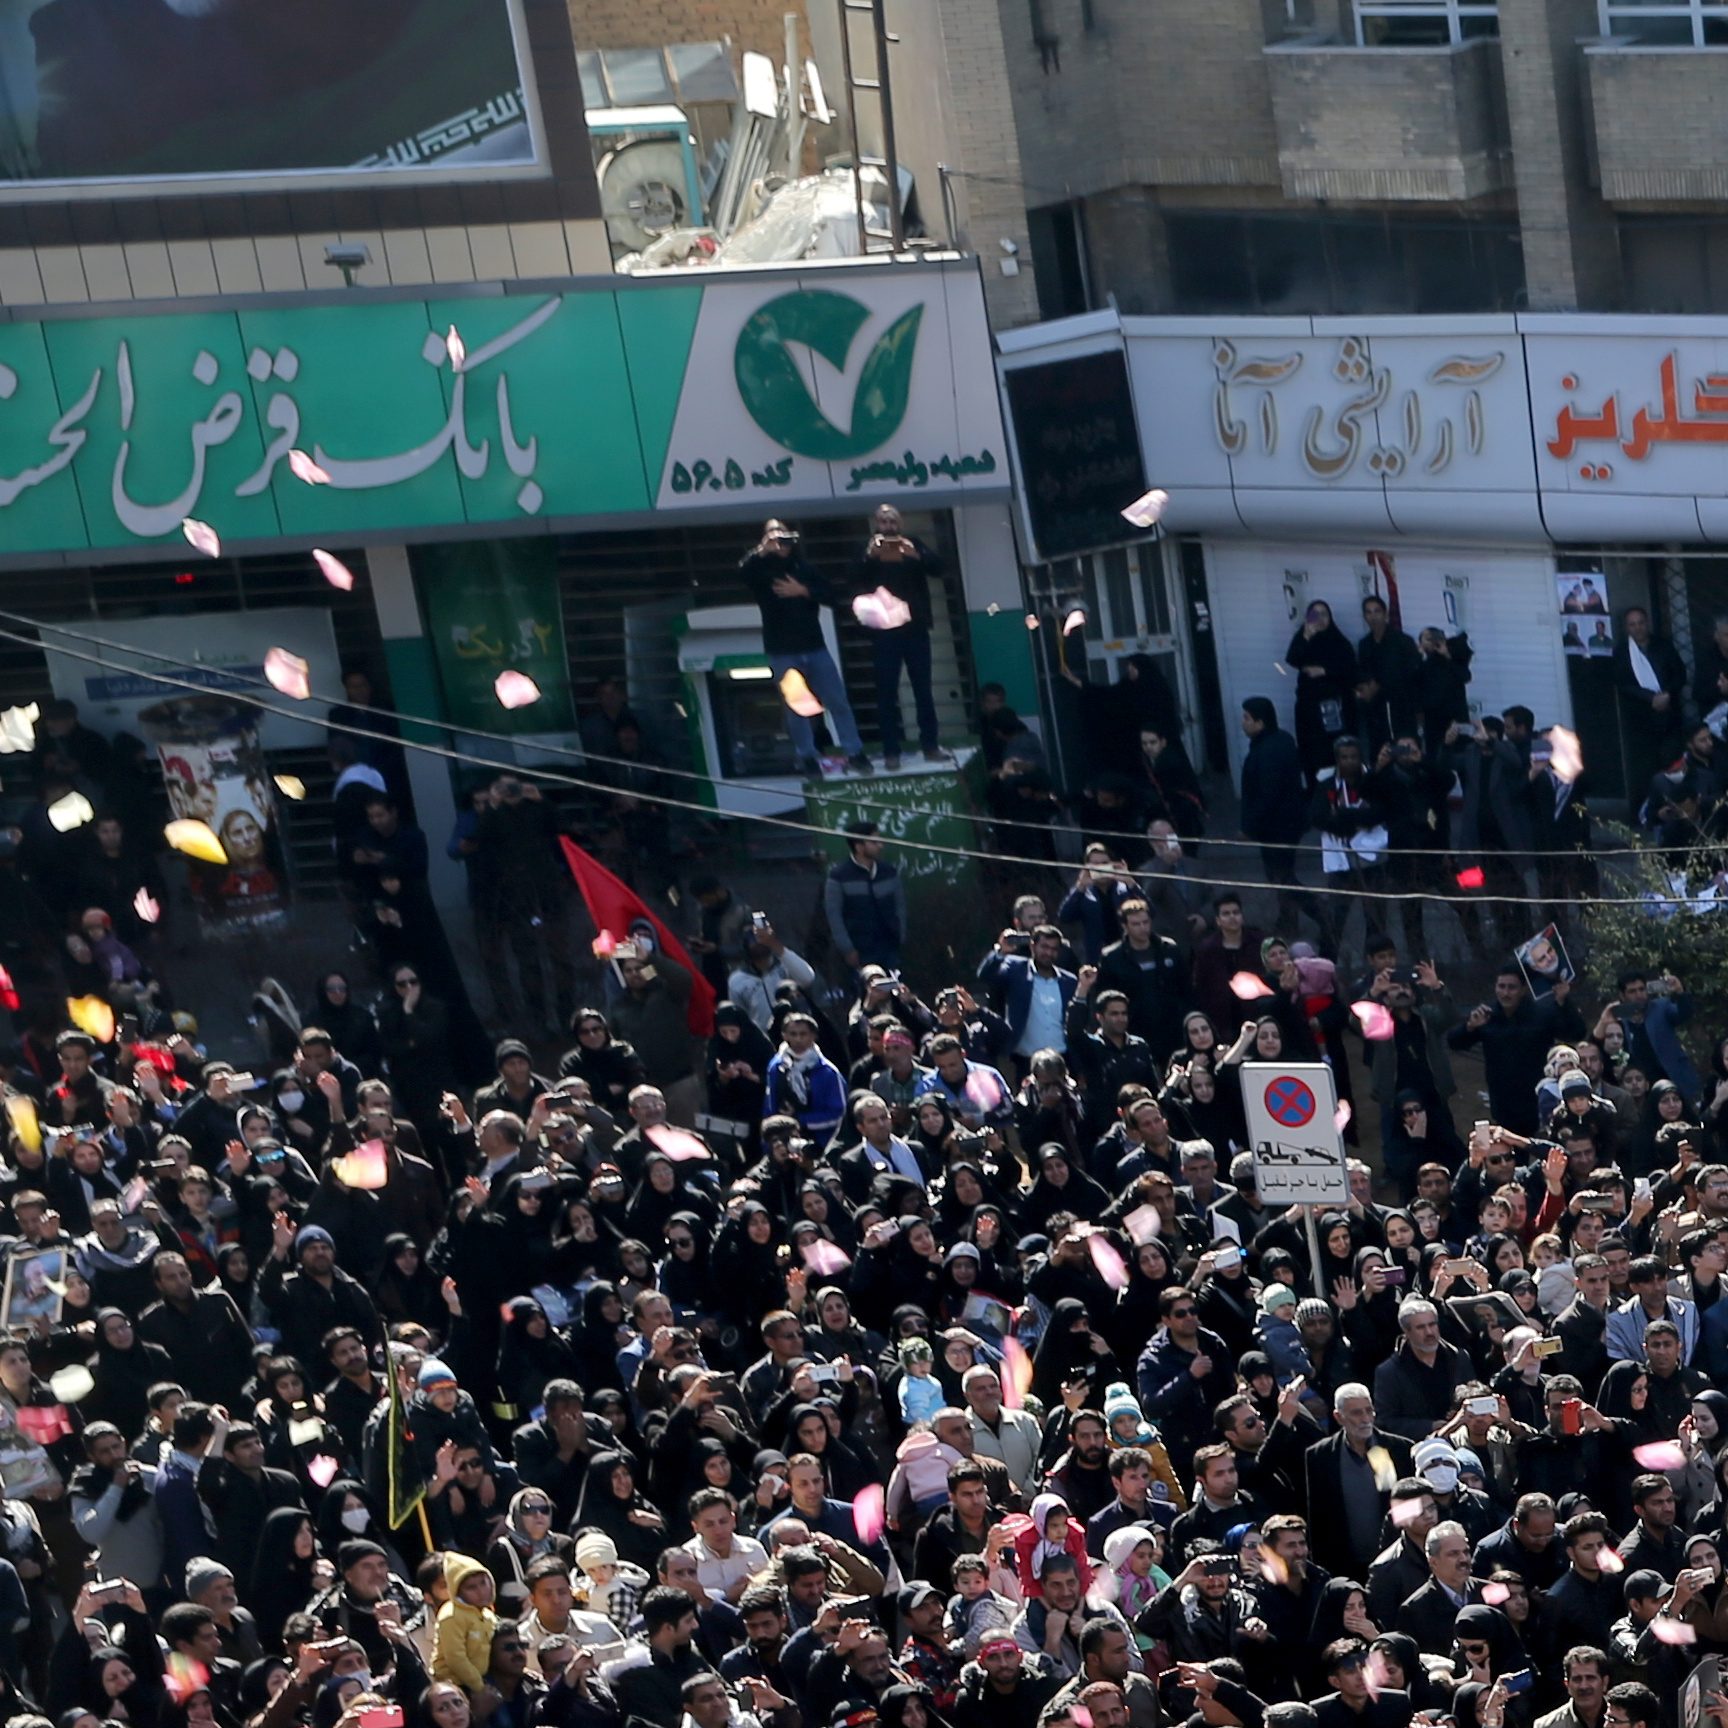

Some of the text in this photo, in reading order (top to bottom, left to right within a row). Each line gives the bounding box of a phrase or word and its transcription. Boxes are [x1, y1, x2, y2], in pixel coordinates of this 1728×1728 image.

[113, 347, 299, 536] قرض
[314, 295, 562, 514] بانک
[1303, 336, 1504, 481] آرایشی
[1260, 1173, 1343, 1192] حمل با جرثقیل
